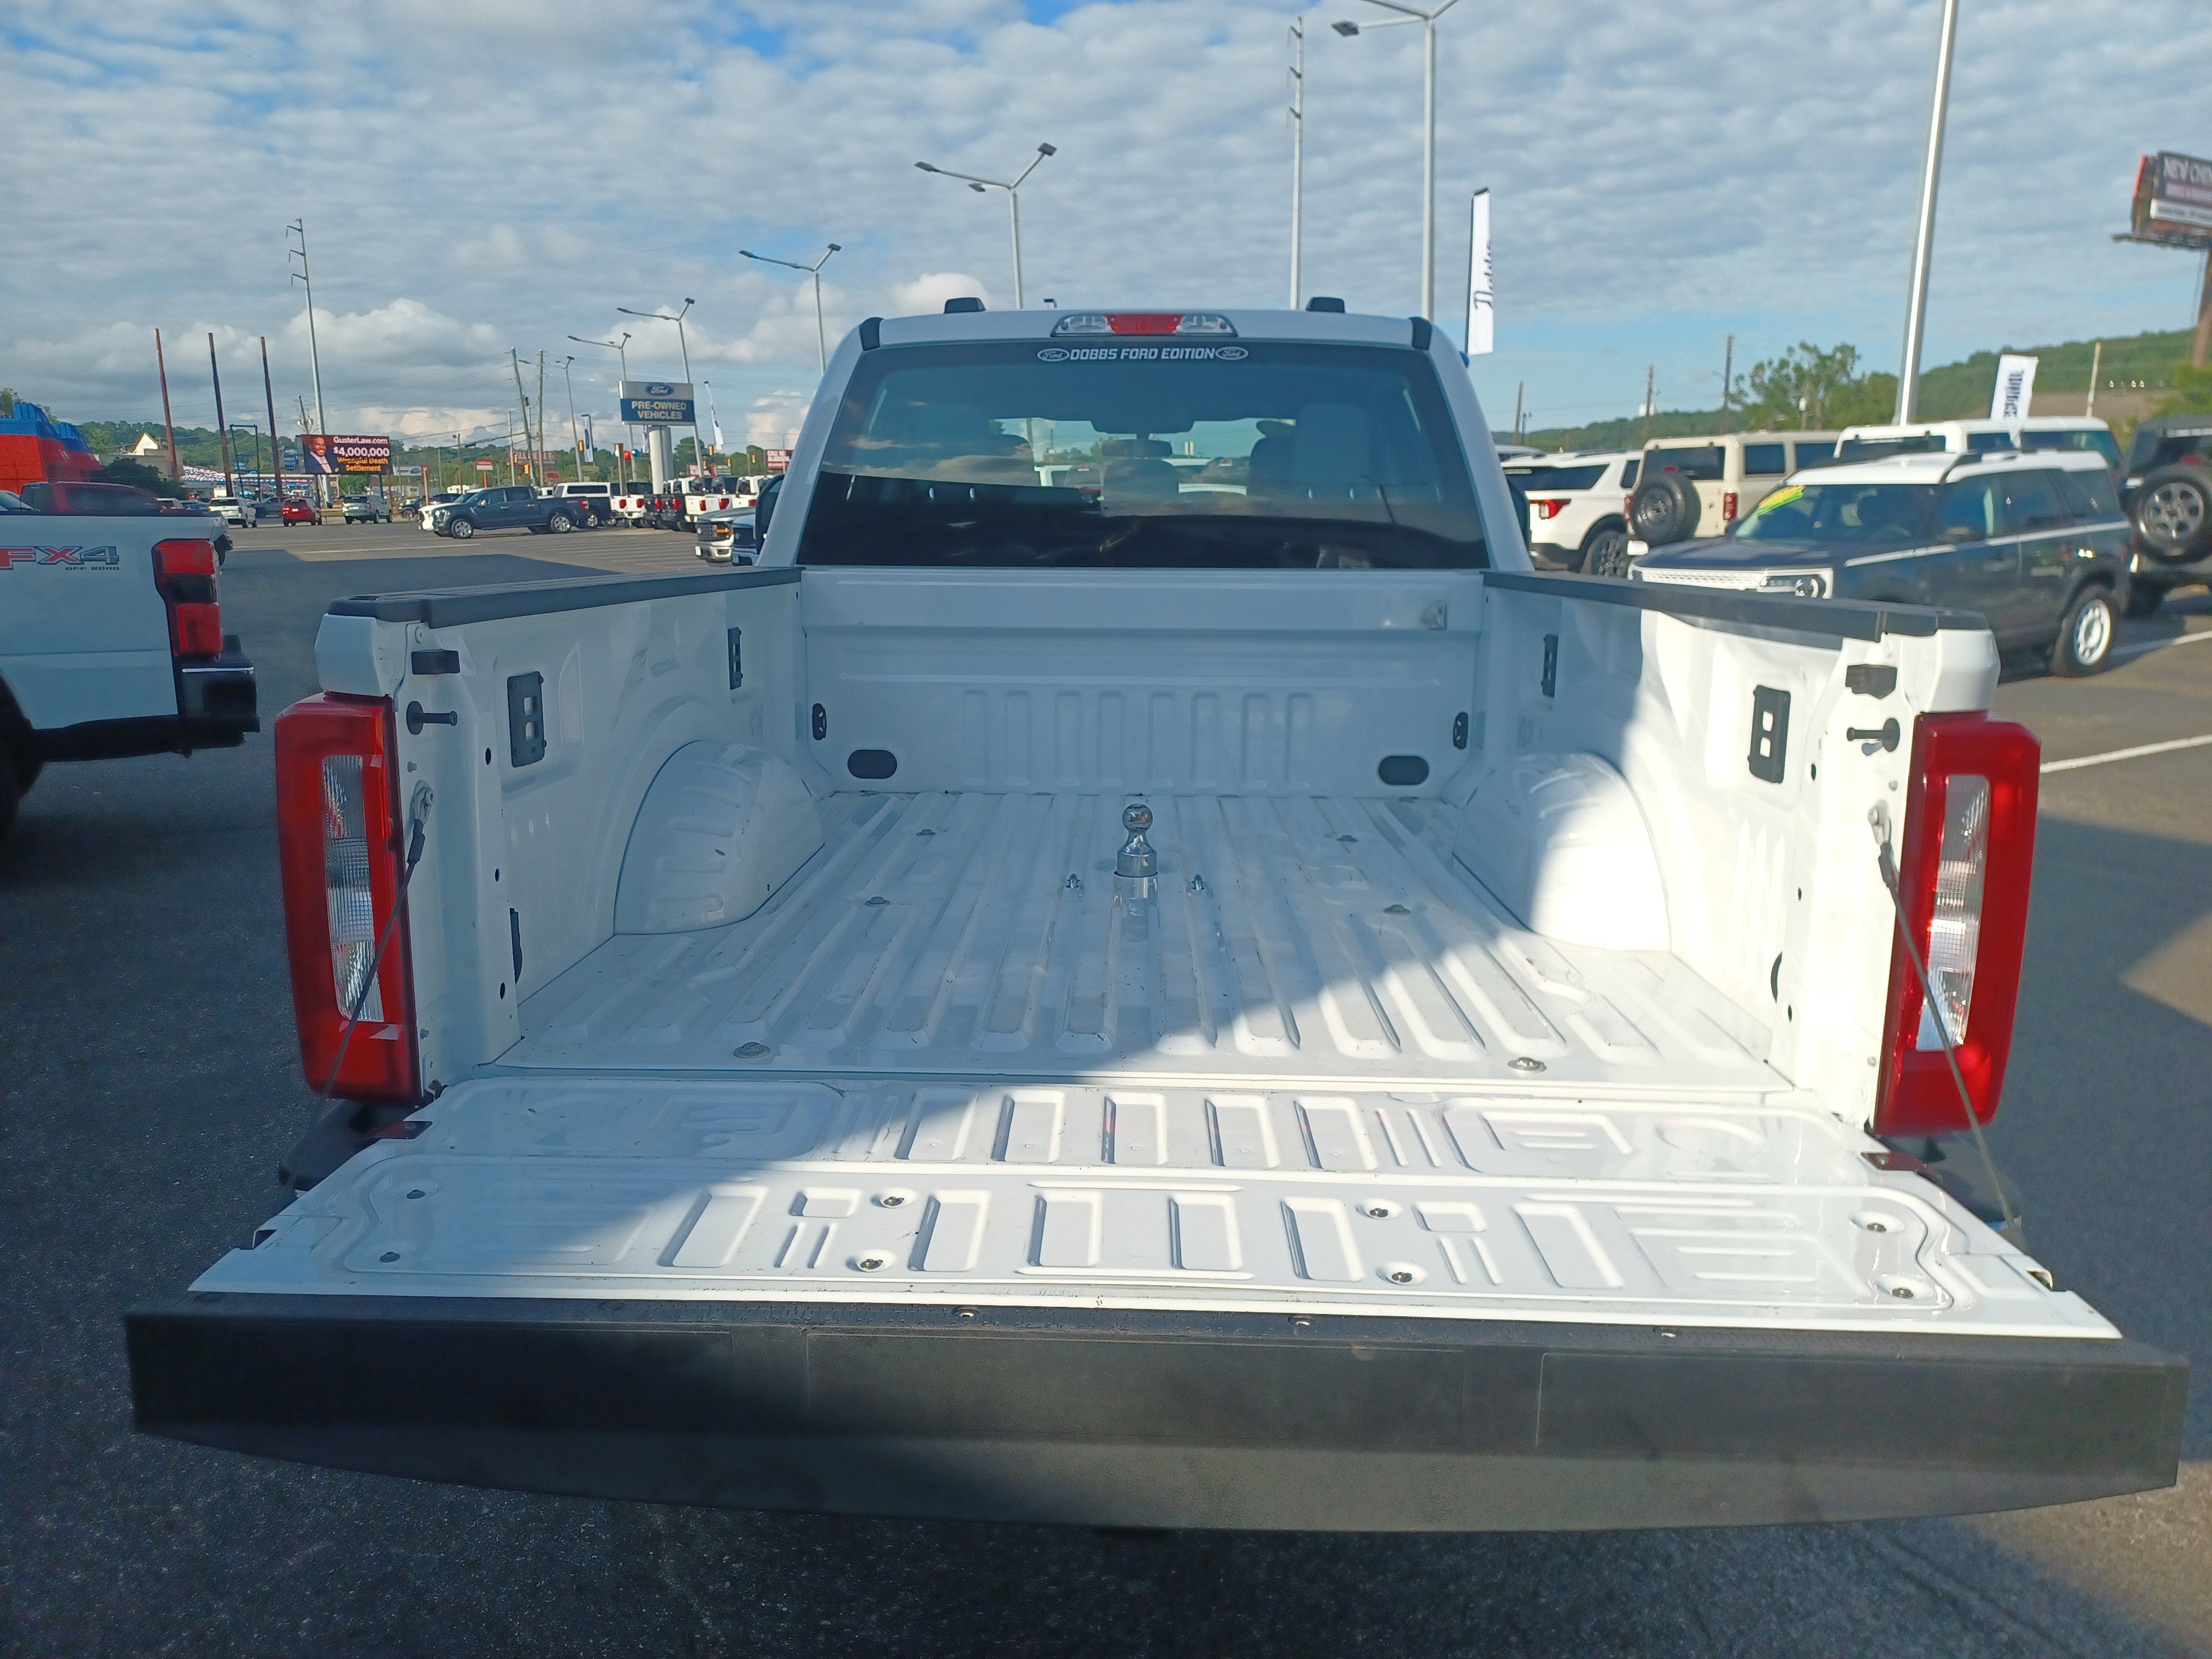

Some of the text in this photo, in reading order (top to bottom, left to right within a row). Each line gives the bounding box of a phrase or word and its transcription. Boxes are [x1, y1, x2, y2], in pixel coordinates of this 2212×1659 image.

[1070, 347, 1215, 360] DOBBS FORD EDITION
[632, 401, 686, 410] PRE-OWNED
[637, 410, 683, 419] VEHICLES
[333, 446, 389, 457] $4,000,000
[0, 546, 119, 570] FX4
